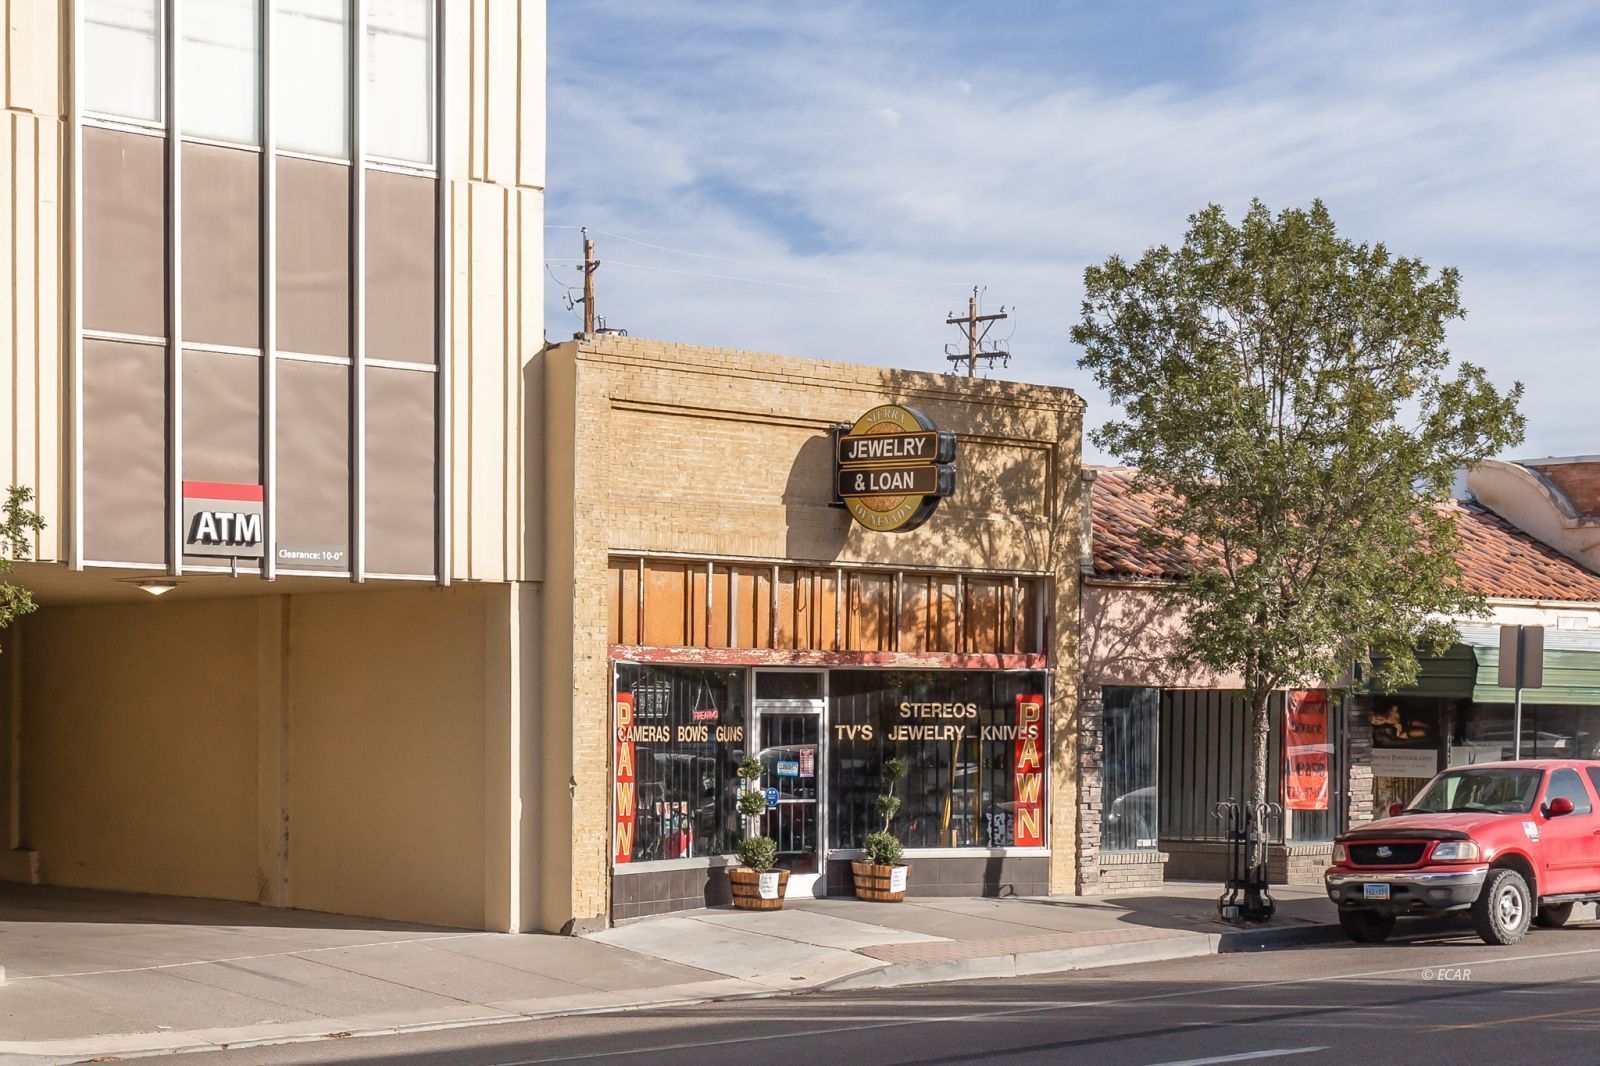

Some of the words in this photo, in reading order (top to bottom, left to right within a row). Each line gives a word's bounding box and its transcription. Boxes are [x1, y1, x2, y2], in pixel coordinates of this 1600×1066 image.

[866, 408, 905, 424] SIERRA
[848, 437, 926, 459] JEWELRY
[854, 473, 865, 491] &
[870, 471, 914, 491] LOAN
[854, 504, 868, 519] OF
[870, 504, 912, 527] NEVADA
[190, 511, 262, 545] ATM
[278, 549, 321, 560] Clearance:
[899, 702, 978, 719] STEREOS
[617, 725, 671, 742] CAMERAS
[677, 725, 709, 742] BOWS
[715, 725, 743, 742] GUNS
[835, 725, 874, 741] TV'S
[888, 725, 966, 742] JEWELRY
[981, 725, 1040, 742] KNIVES
[616, 701, 634, 856] PAWN
[1015, 702, 1042, 839] PAWN
